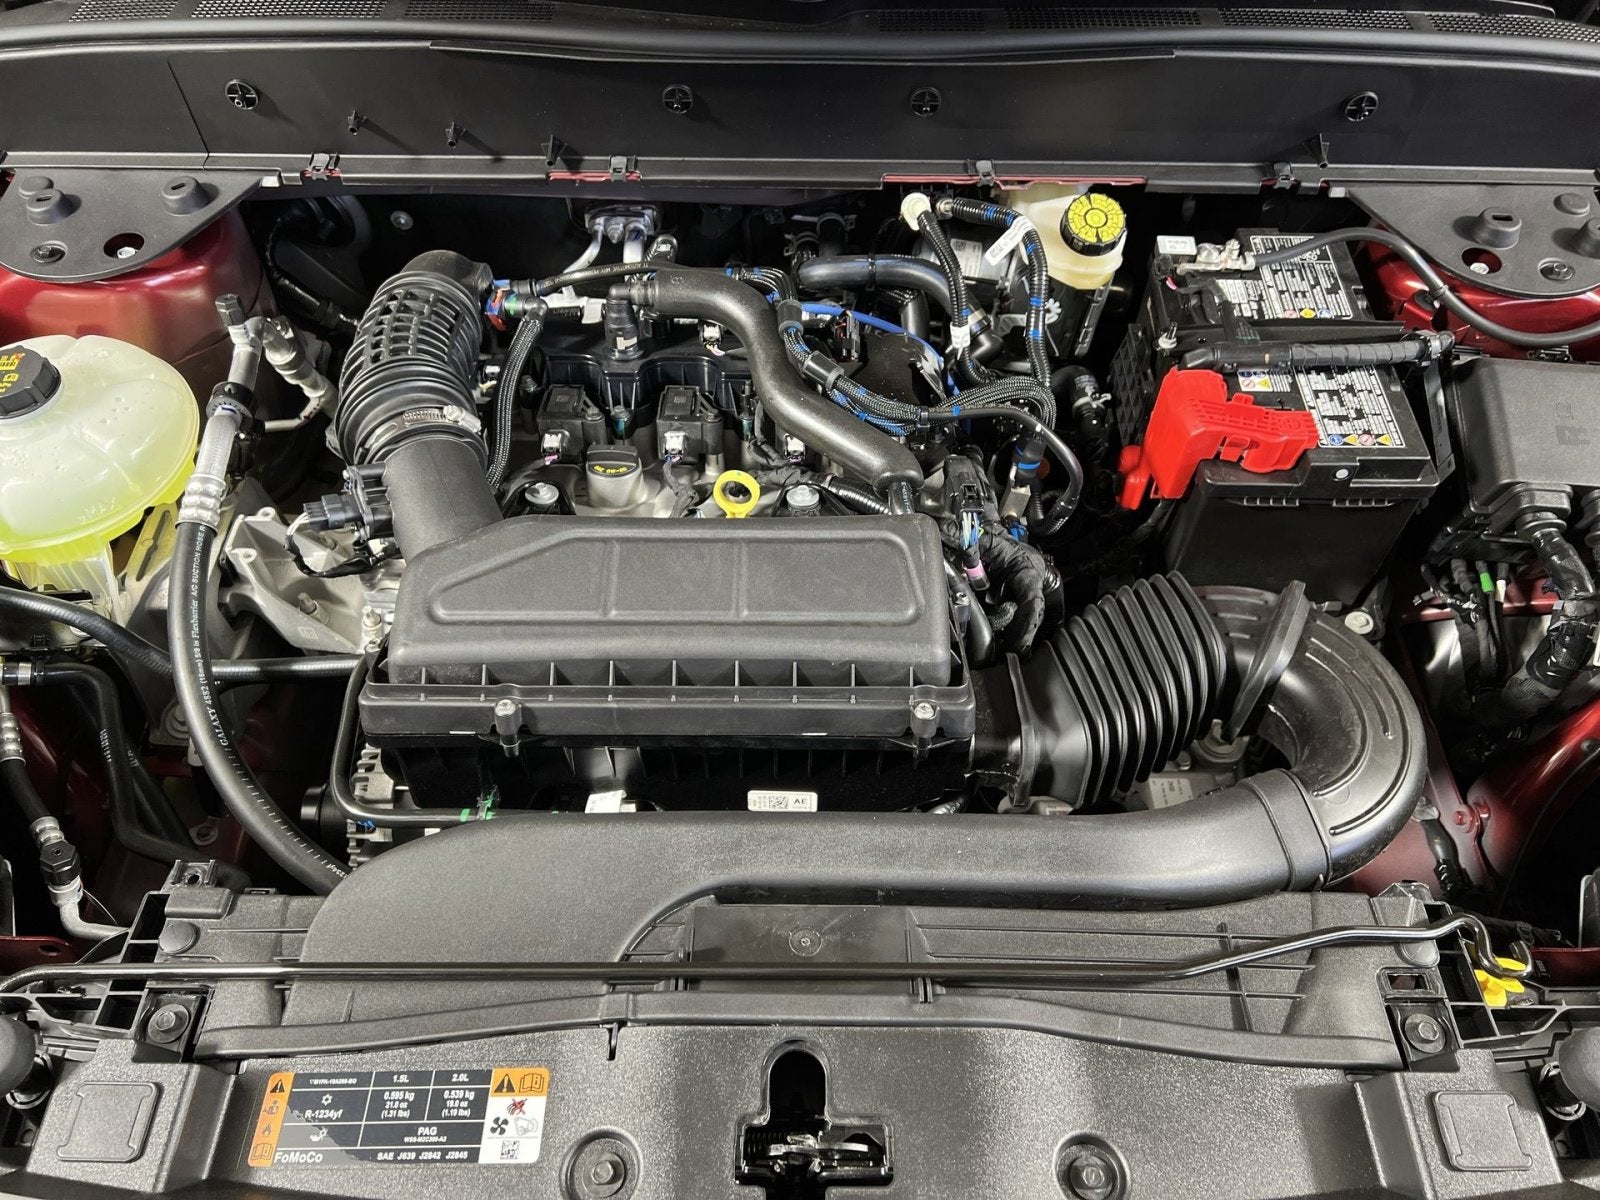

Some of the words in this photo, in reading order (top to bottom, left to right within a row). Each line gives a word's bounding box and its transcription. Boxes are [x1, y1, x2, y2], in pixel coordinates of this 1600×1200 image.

[195, 531, 205, 551] HOSE
[191, 551, 201, 583] SUCTION
[190, 584, 199, 597] A/C
[190, 600, 200, 639] Flexbarrier
[206, 706, 229, 746] GALAXY
[392, 1074, 409, 1083] 1.5L
[451, 1073, 469, 1082] 2.0L
[404, 1091, 415, 1102] kg
[464, 1090, 475, 1101] kg
[304, 1109, 344, 1120] R-1234yf
[397, 1109, 410, 1118] lbs)
[458, 1108, 471, 1117] lbs)
[417, 1126, 438, 1136] PAG
[273, 1151, 323, 1163] FoMoCo
[377, 1152, 394, 1160] SAE
[397, 1151, 416, 1160] J639
